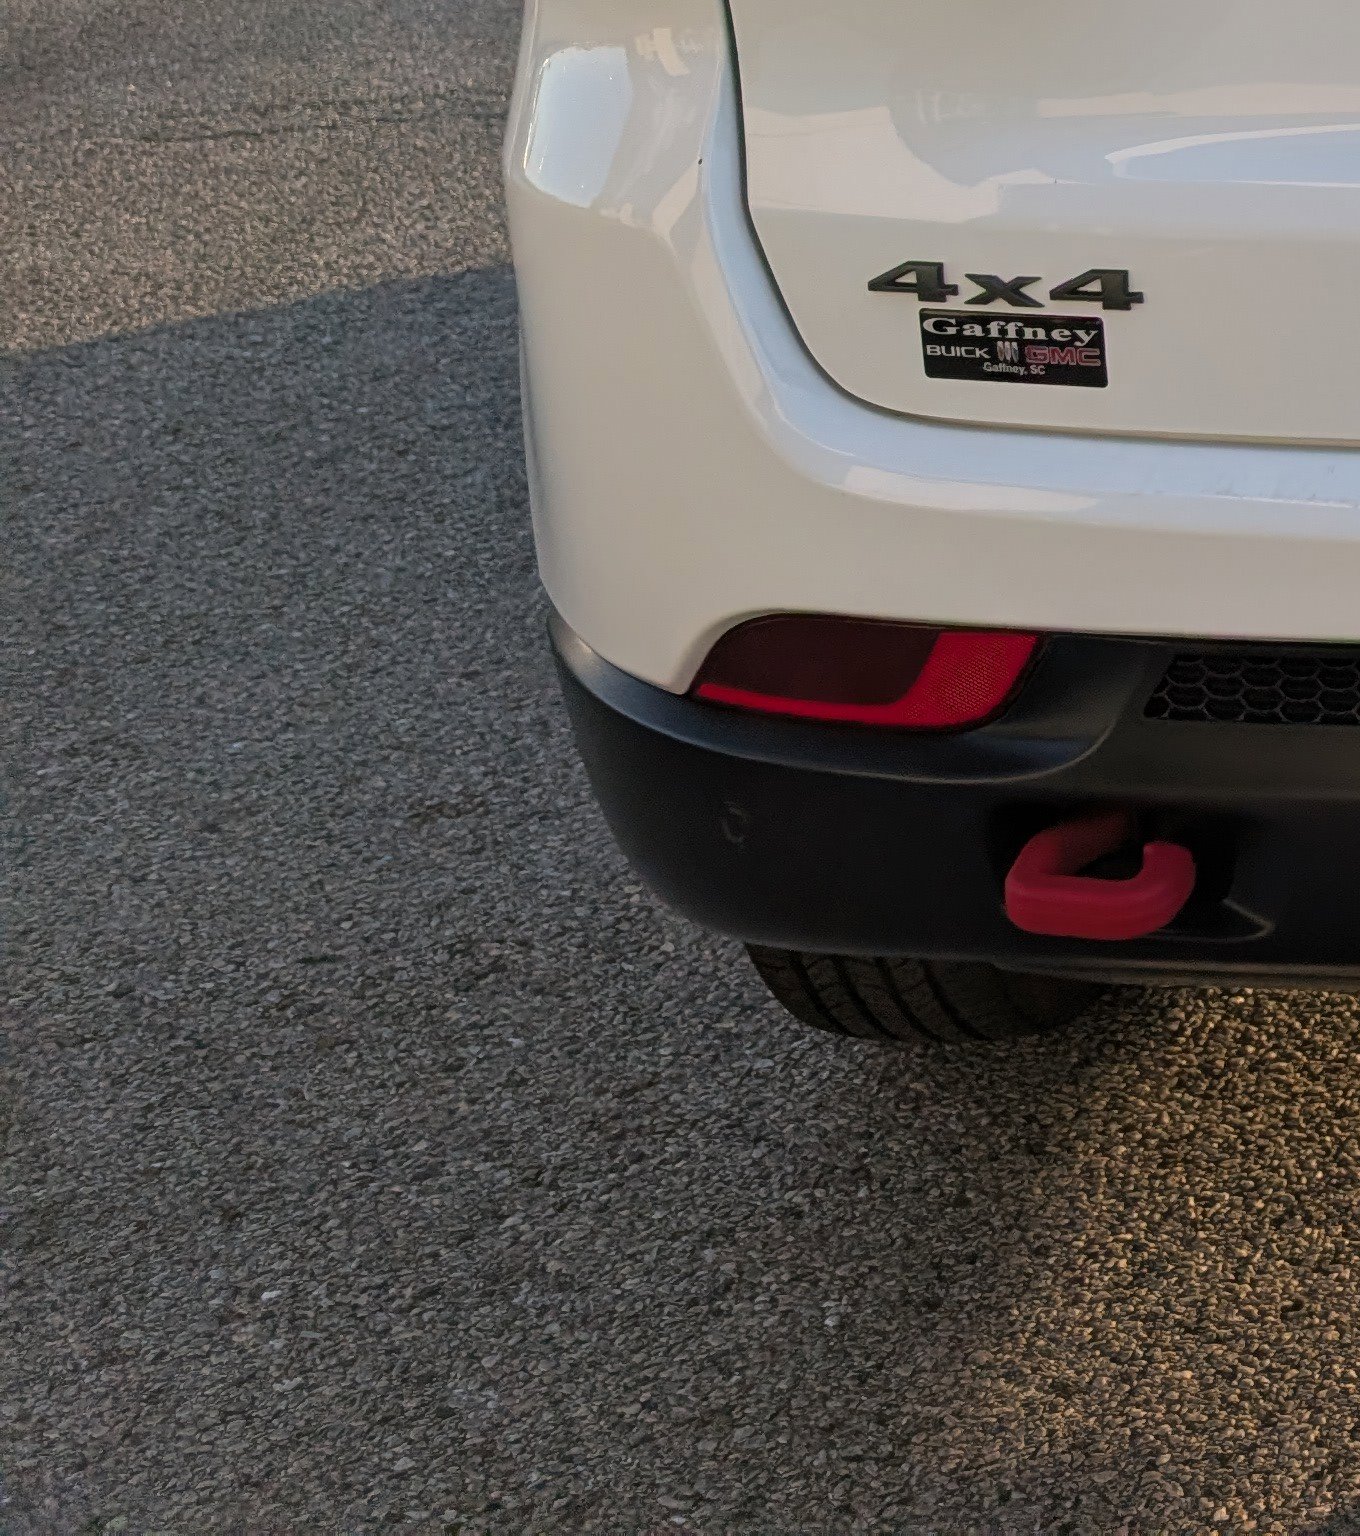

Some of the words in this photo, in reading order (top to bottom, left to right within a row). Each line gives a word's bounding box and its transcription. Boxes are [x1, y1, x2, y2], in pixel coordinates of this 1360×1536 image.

[867, 260, 1145, 310] 4x4
[922, 317, 1099, 346] Gaffney
[926, 344, 991, 359] BUICK
[1024, 345, 1101, 367] GMC
[1030, 364, 1046, 375] SC
